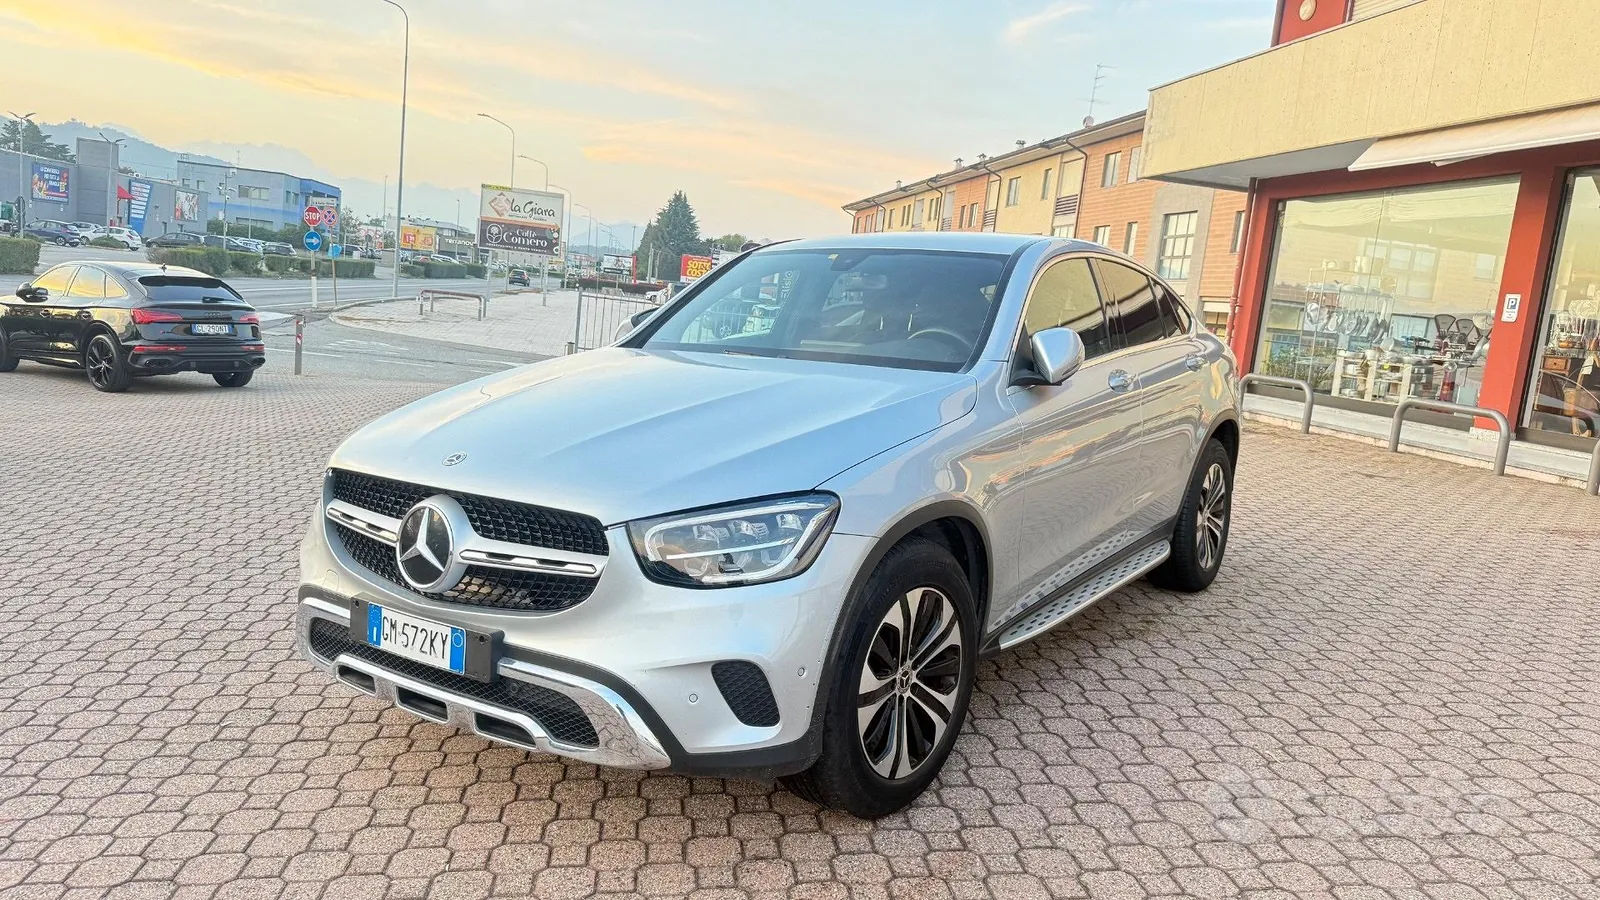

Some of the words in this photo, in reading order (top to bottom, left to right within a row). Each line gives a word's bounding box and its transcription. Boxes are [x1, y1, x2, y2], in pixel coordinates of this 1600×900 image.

[523, 201, 556, 218] Giara
[305, 212, 321, 221] STOP
[503, 231, 548, 247] Comero
[686, 268, 707, 277] COST
